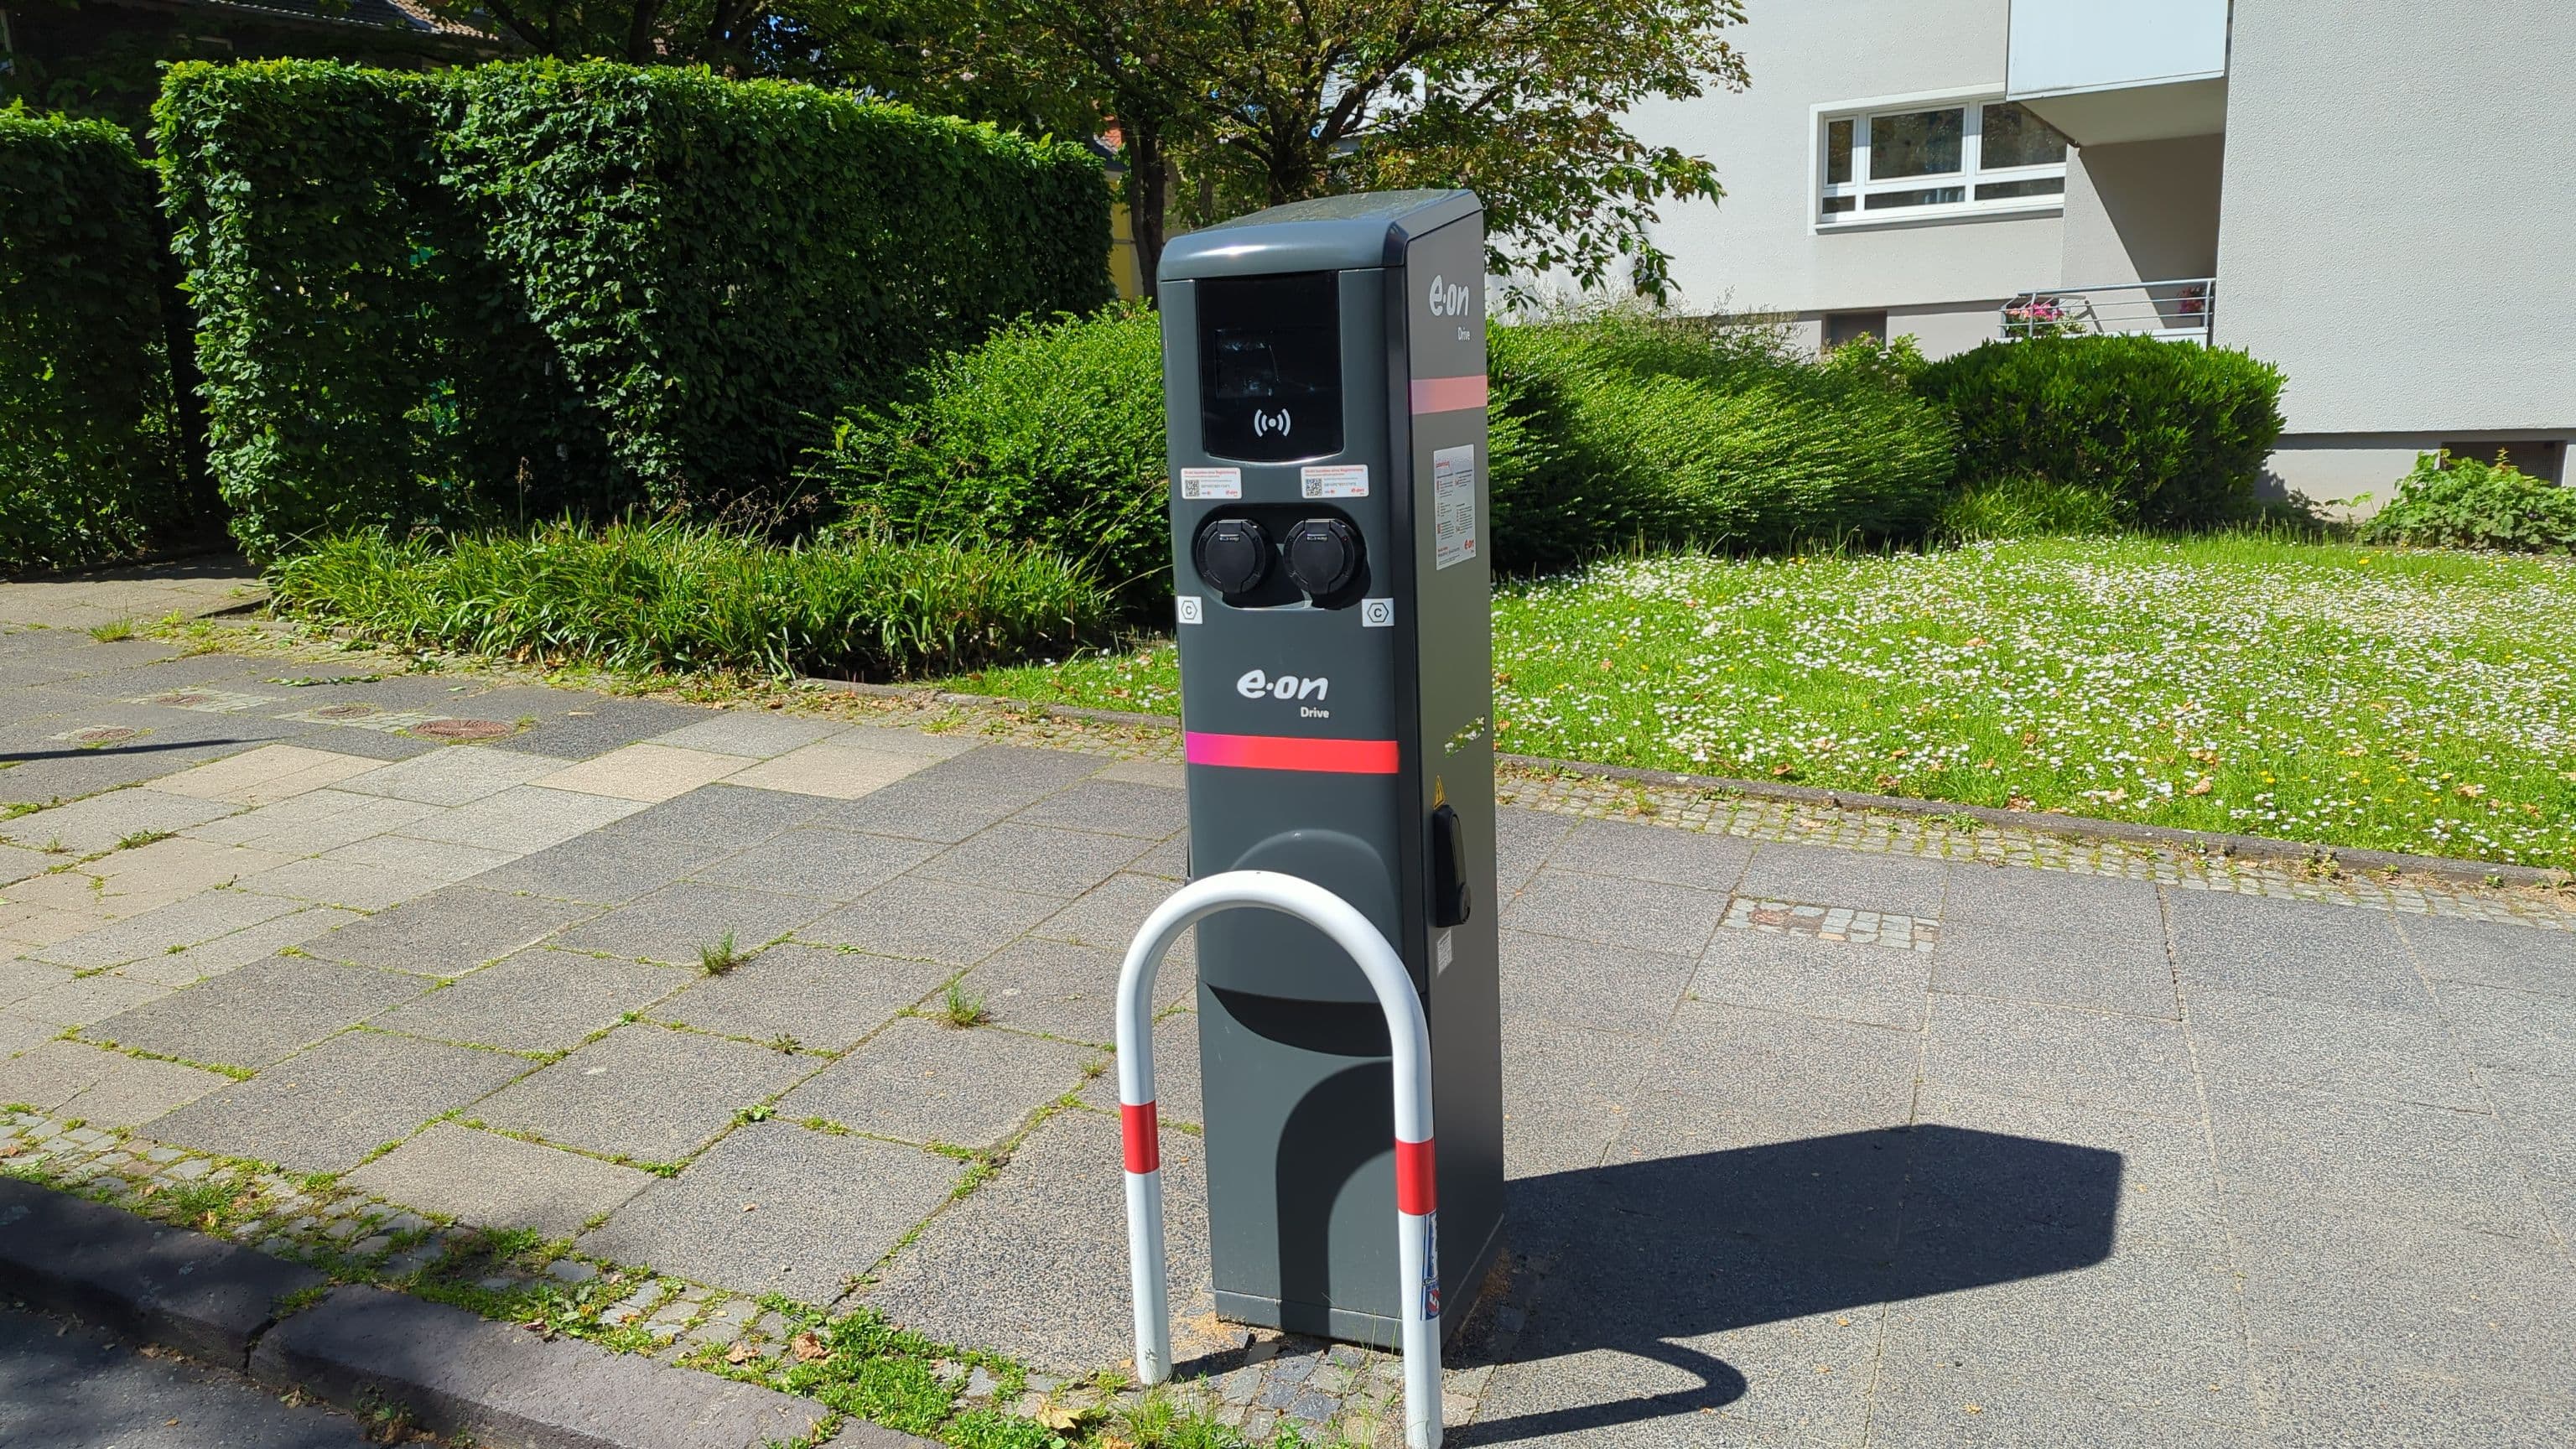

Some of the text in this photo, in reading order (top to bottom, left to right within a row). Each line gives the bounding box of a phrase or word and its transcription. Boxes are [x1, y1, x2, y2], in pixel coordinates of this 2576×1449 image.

[1457, 326, 1470, 340] Drive
[1186, 606, 1192, 615] C
[1374, 608, 1383, 618] C
[1301, 707, 1329, 718] Drive
